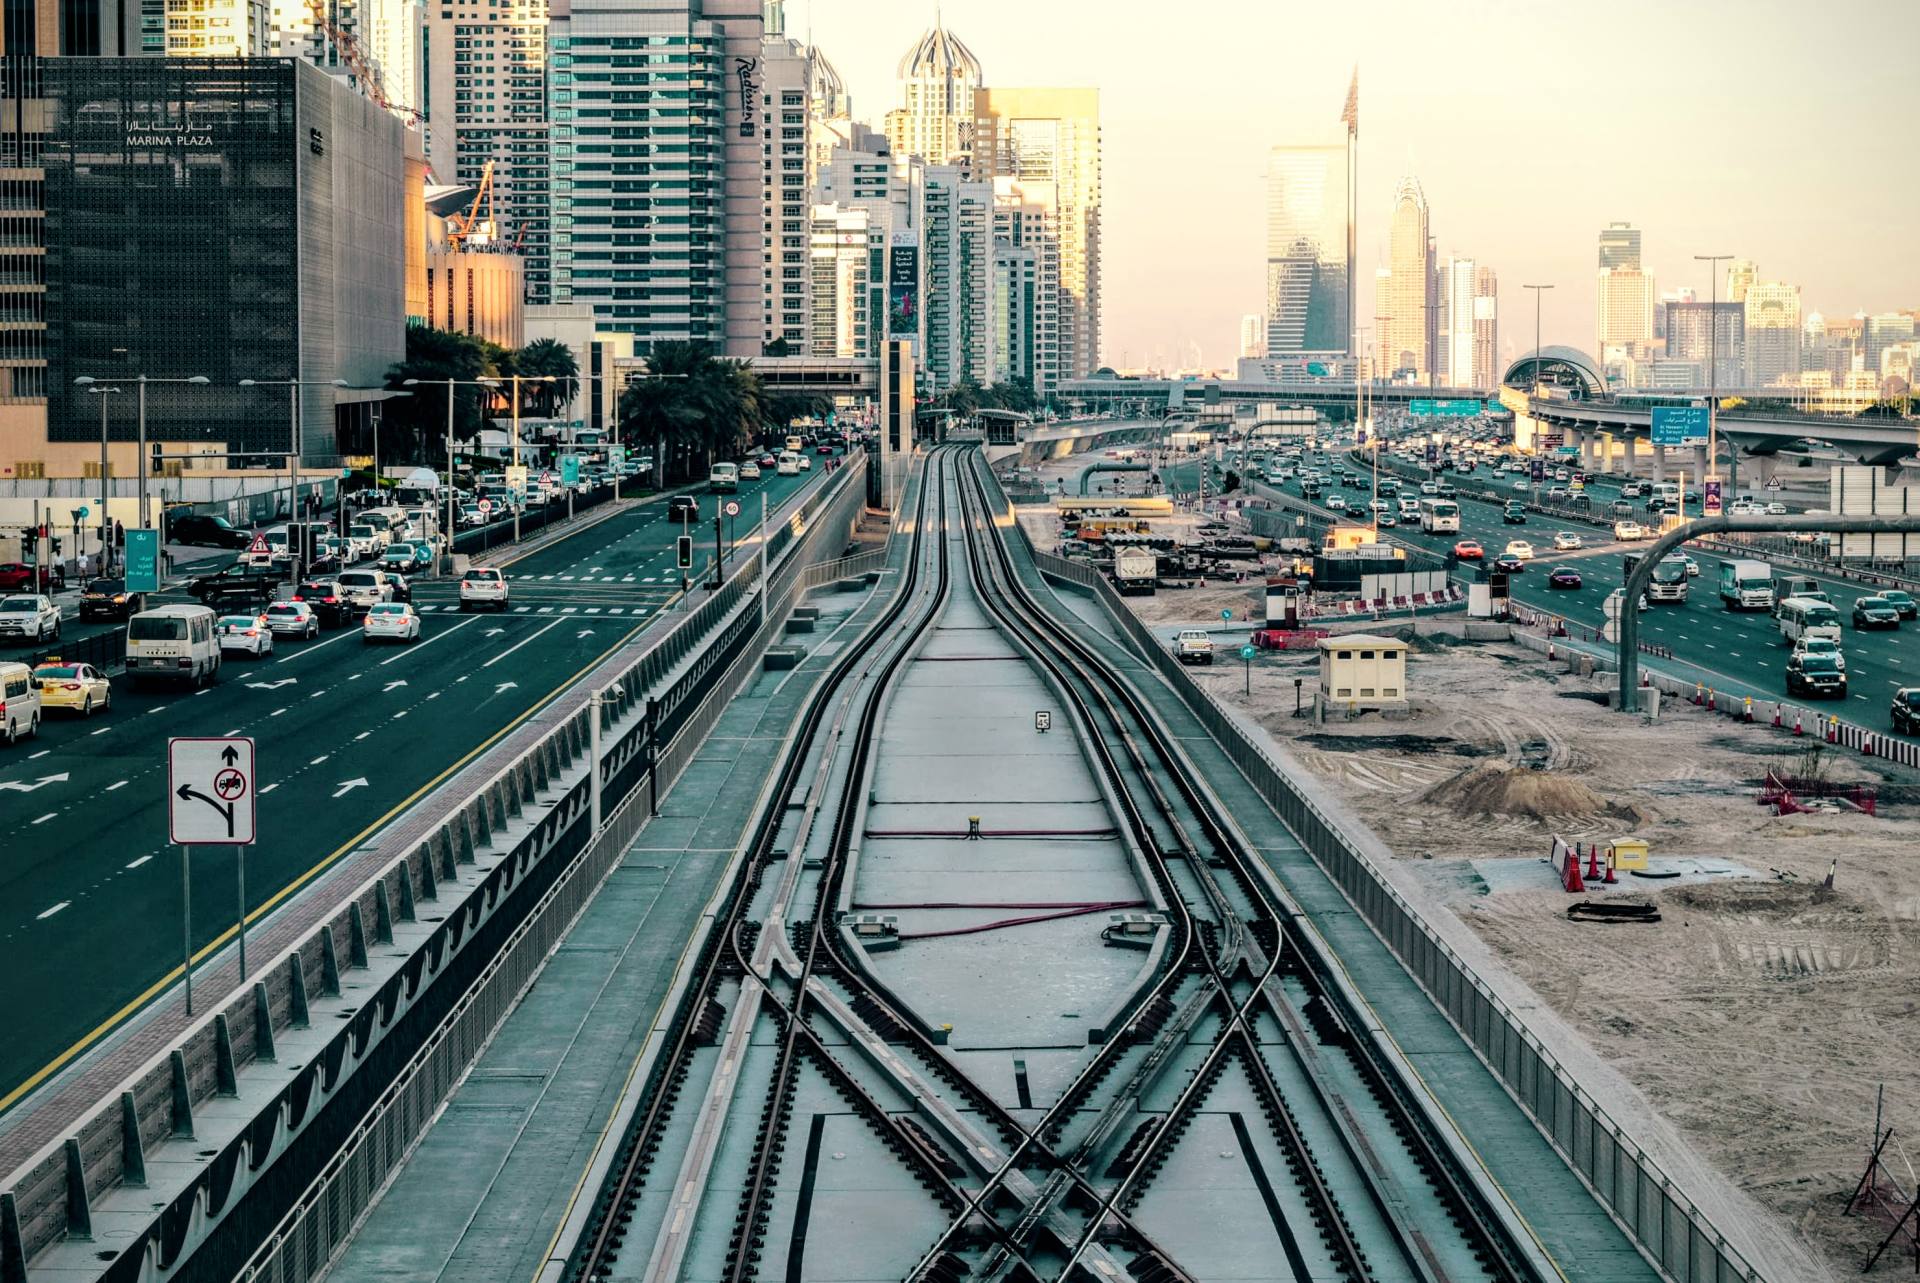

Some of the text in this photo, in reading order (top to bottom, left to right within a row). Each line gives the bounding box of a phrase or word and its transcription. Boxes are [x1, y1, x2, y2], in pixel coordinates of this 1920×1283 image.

[735, 57, 760, 122] Radisson
[126, 136, 213, 146] MARINA PLAZA
[1037, 719, 1049, 728] 45
